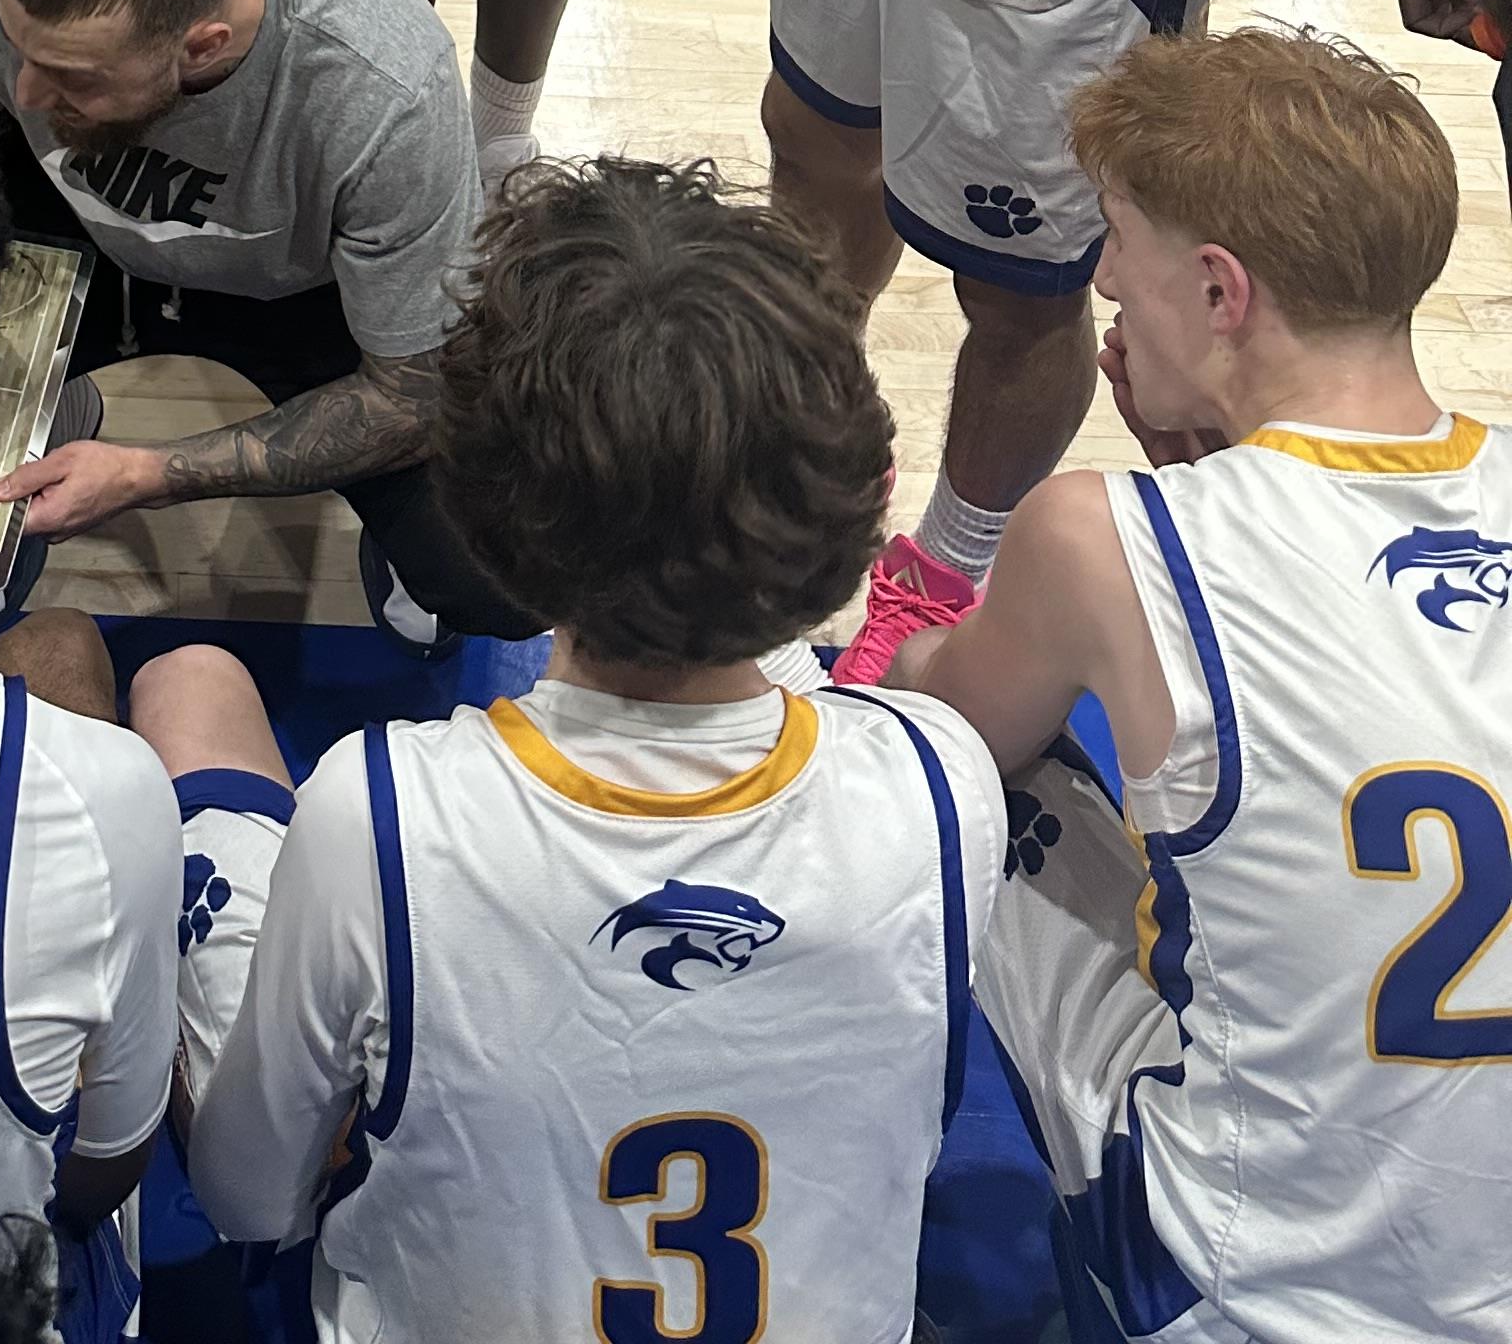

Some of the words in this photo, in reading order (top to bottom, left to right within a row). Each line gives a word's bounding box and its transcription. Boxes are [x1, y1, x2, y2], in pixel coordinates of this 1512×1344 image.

[68, 146, 228, 229] NIKE
[1341, 759, 1512, 1068] 2
[593, 1110, 770, 1344] 3
